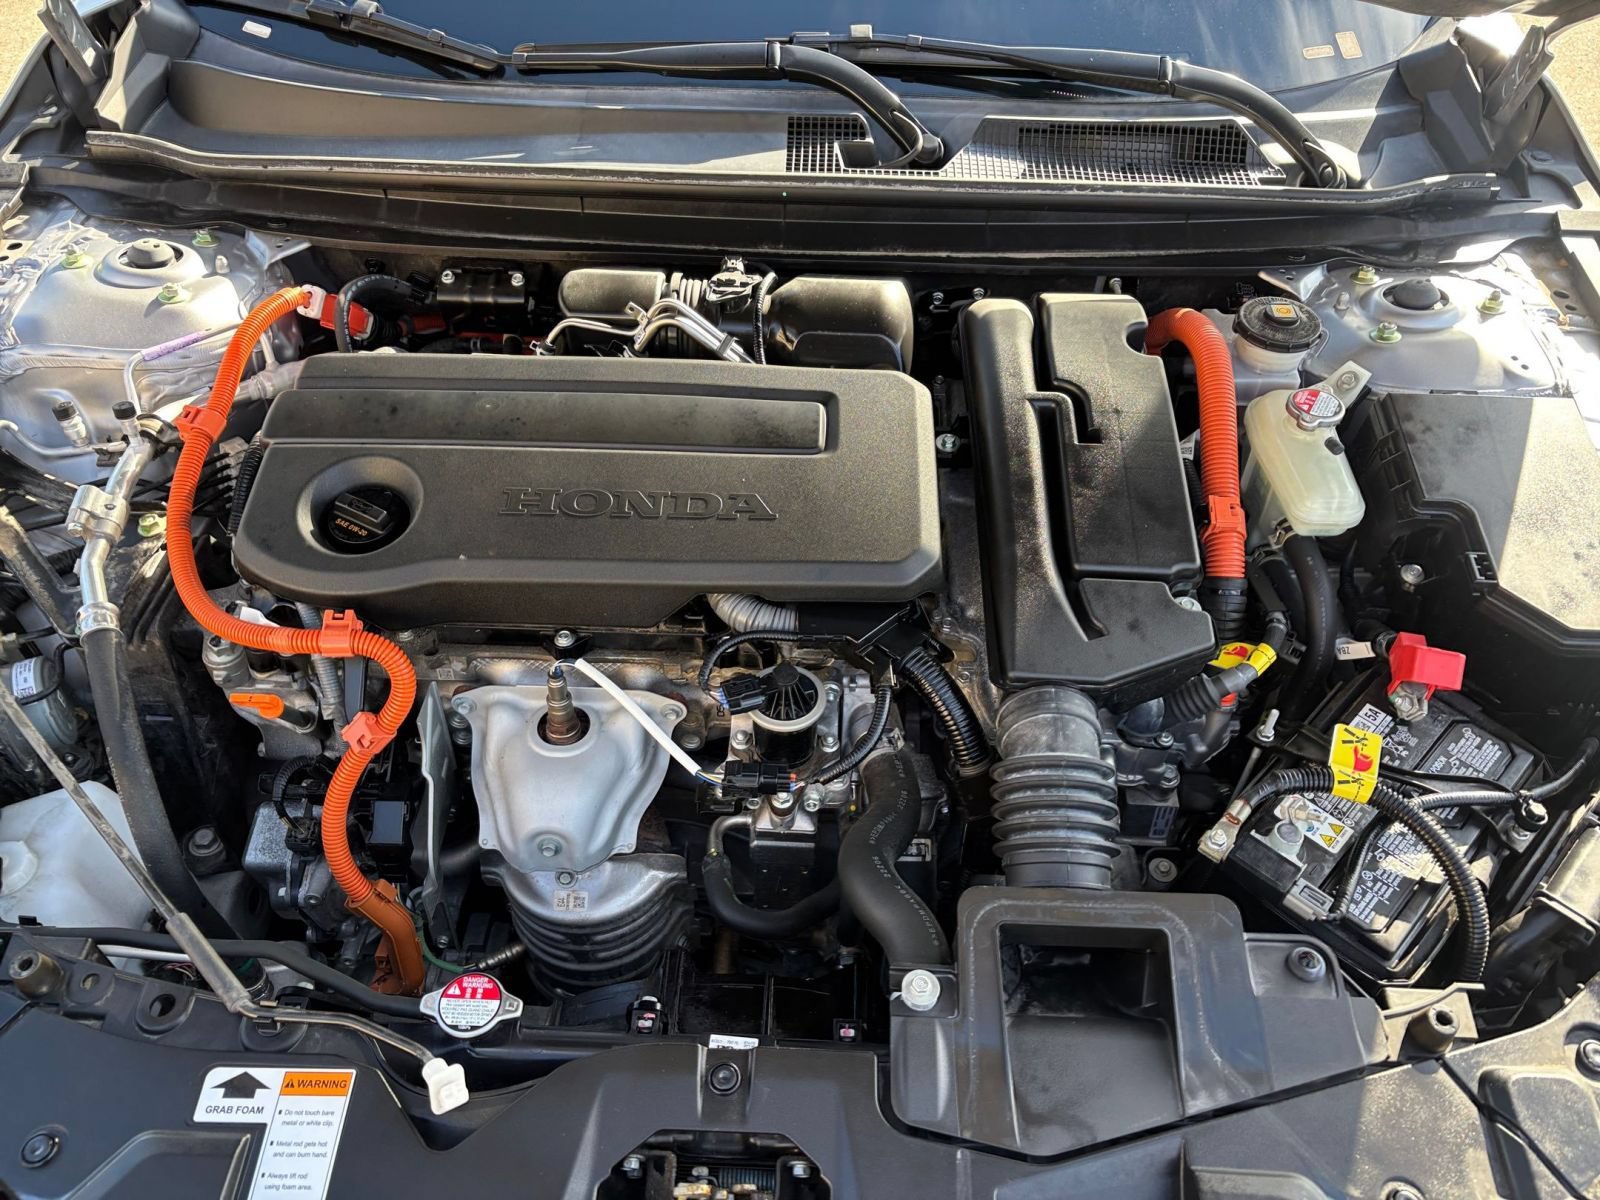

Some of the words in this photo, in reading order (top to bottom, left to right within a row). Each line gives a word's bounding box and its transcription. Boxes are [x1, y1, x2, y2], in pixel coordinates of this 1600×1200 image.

[499, 487, 779, 519] HONDA
[335, 518, 350, 528] SAE
[1364, 708, 1382, 722] 5A
[297, 1079, 347, 1089] WARNING
[205, 1105, 233, 1115] GRAB
[235, 1105, 264, 1115] FOAM
[321, 1109, 335, 1117] bare
[281, 1119, 298, 1127] metal
[306, 1119, 322, 1127] white
[322, 1119, 334, 1128] clip.
[275, 1140, 292, 1148] Metal
[293, 1140, 303, 1148] rod
[304, 1141, 317, 1149] gets
[317, 1140, 327, 1148] hot
[267, 1172, 288, 1181] Always
[289, 1172, 297, 1180] lift
[298, 1172, 308, 1180] rod
[264, 1184, 281, 1192] using
[281, 1183, 296, 1191] foam
